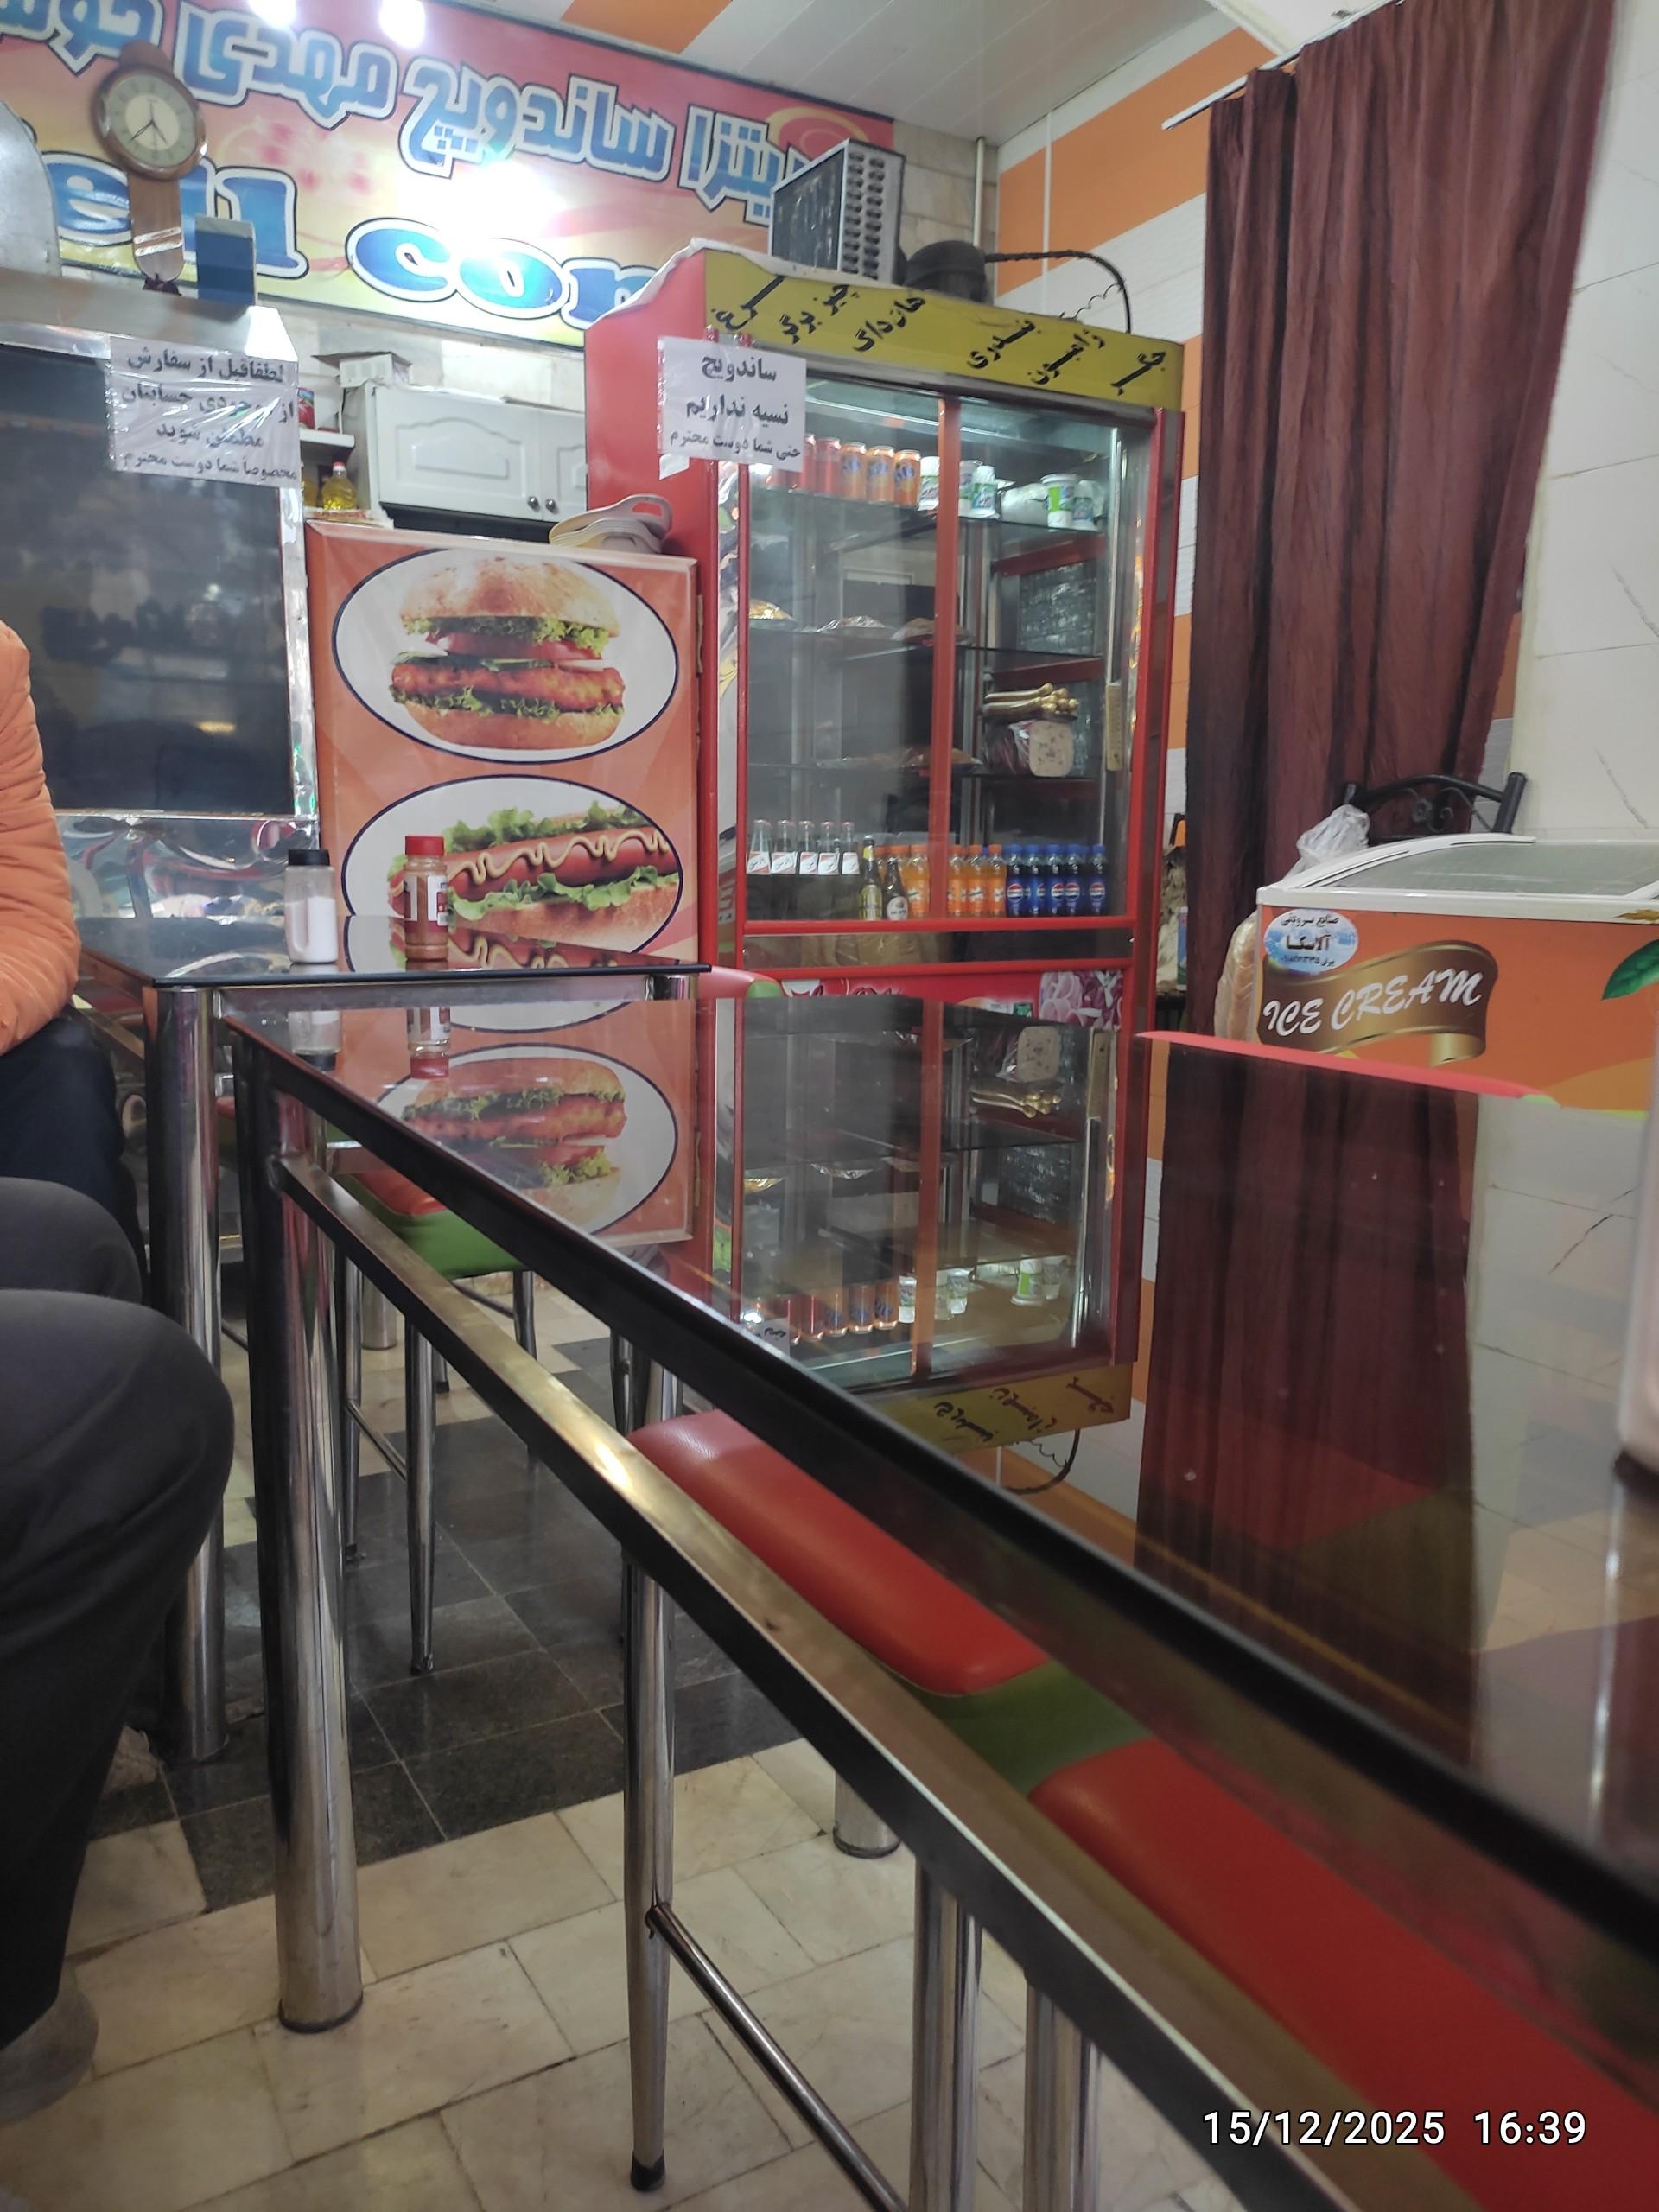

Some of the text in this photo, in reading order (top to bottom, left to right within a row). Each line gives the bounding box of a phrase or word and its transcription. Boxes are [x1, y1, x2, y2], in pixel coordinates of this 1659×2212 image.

[175, 3, 398, 130] مهدی
[398, 56, 677, 181] ساندویچ
[677, 103, 810, 226] یتزا
[711, 275, 787, 331] رغ
[967, 320, 1042, 369] بندری
[128, 346, 191, 372] سفارش
[198, 355, 213, 378] از
[702, 355, 777, 382] ساندویچ
[278, 400, 295, 423] از
[686, 394, 789, 428] نسیه نداریم
[713, 435, 749, 454] دوست
[753, 437, 772, 454] شما
[776, 446, 801, 461] حتی
[172, 455, 212, 474] دوست
[216, 458, 239, 474] شما
[1262, 968, 1484, 1037] ICE CREAM
